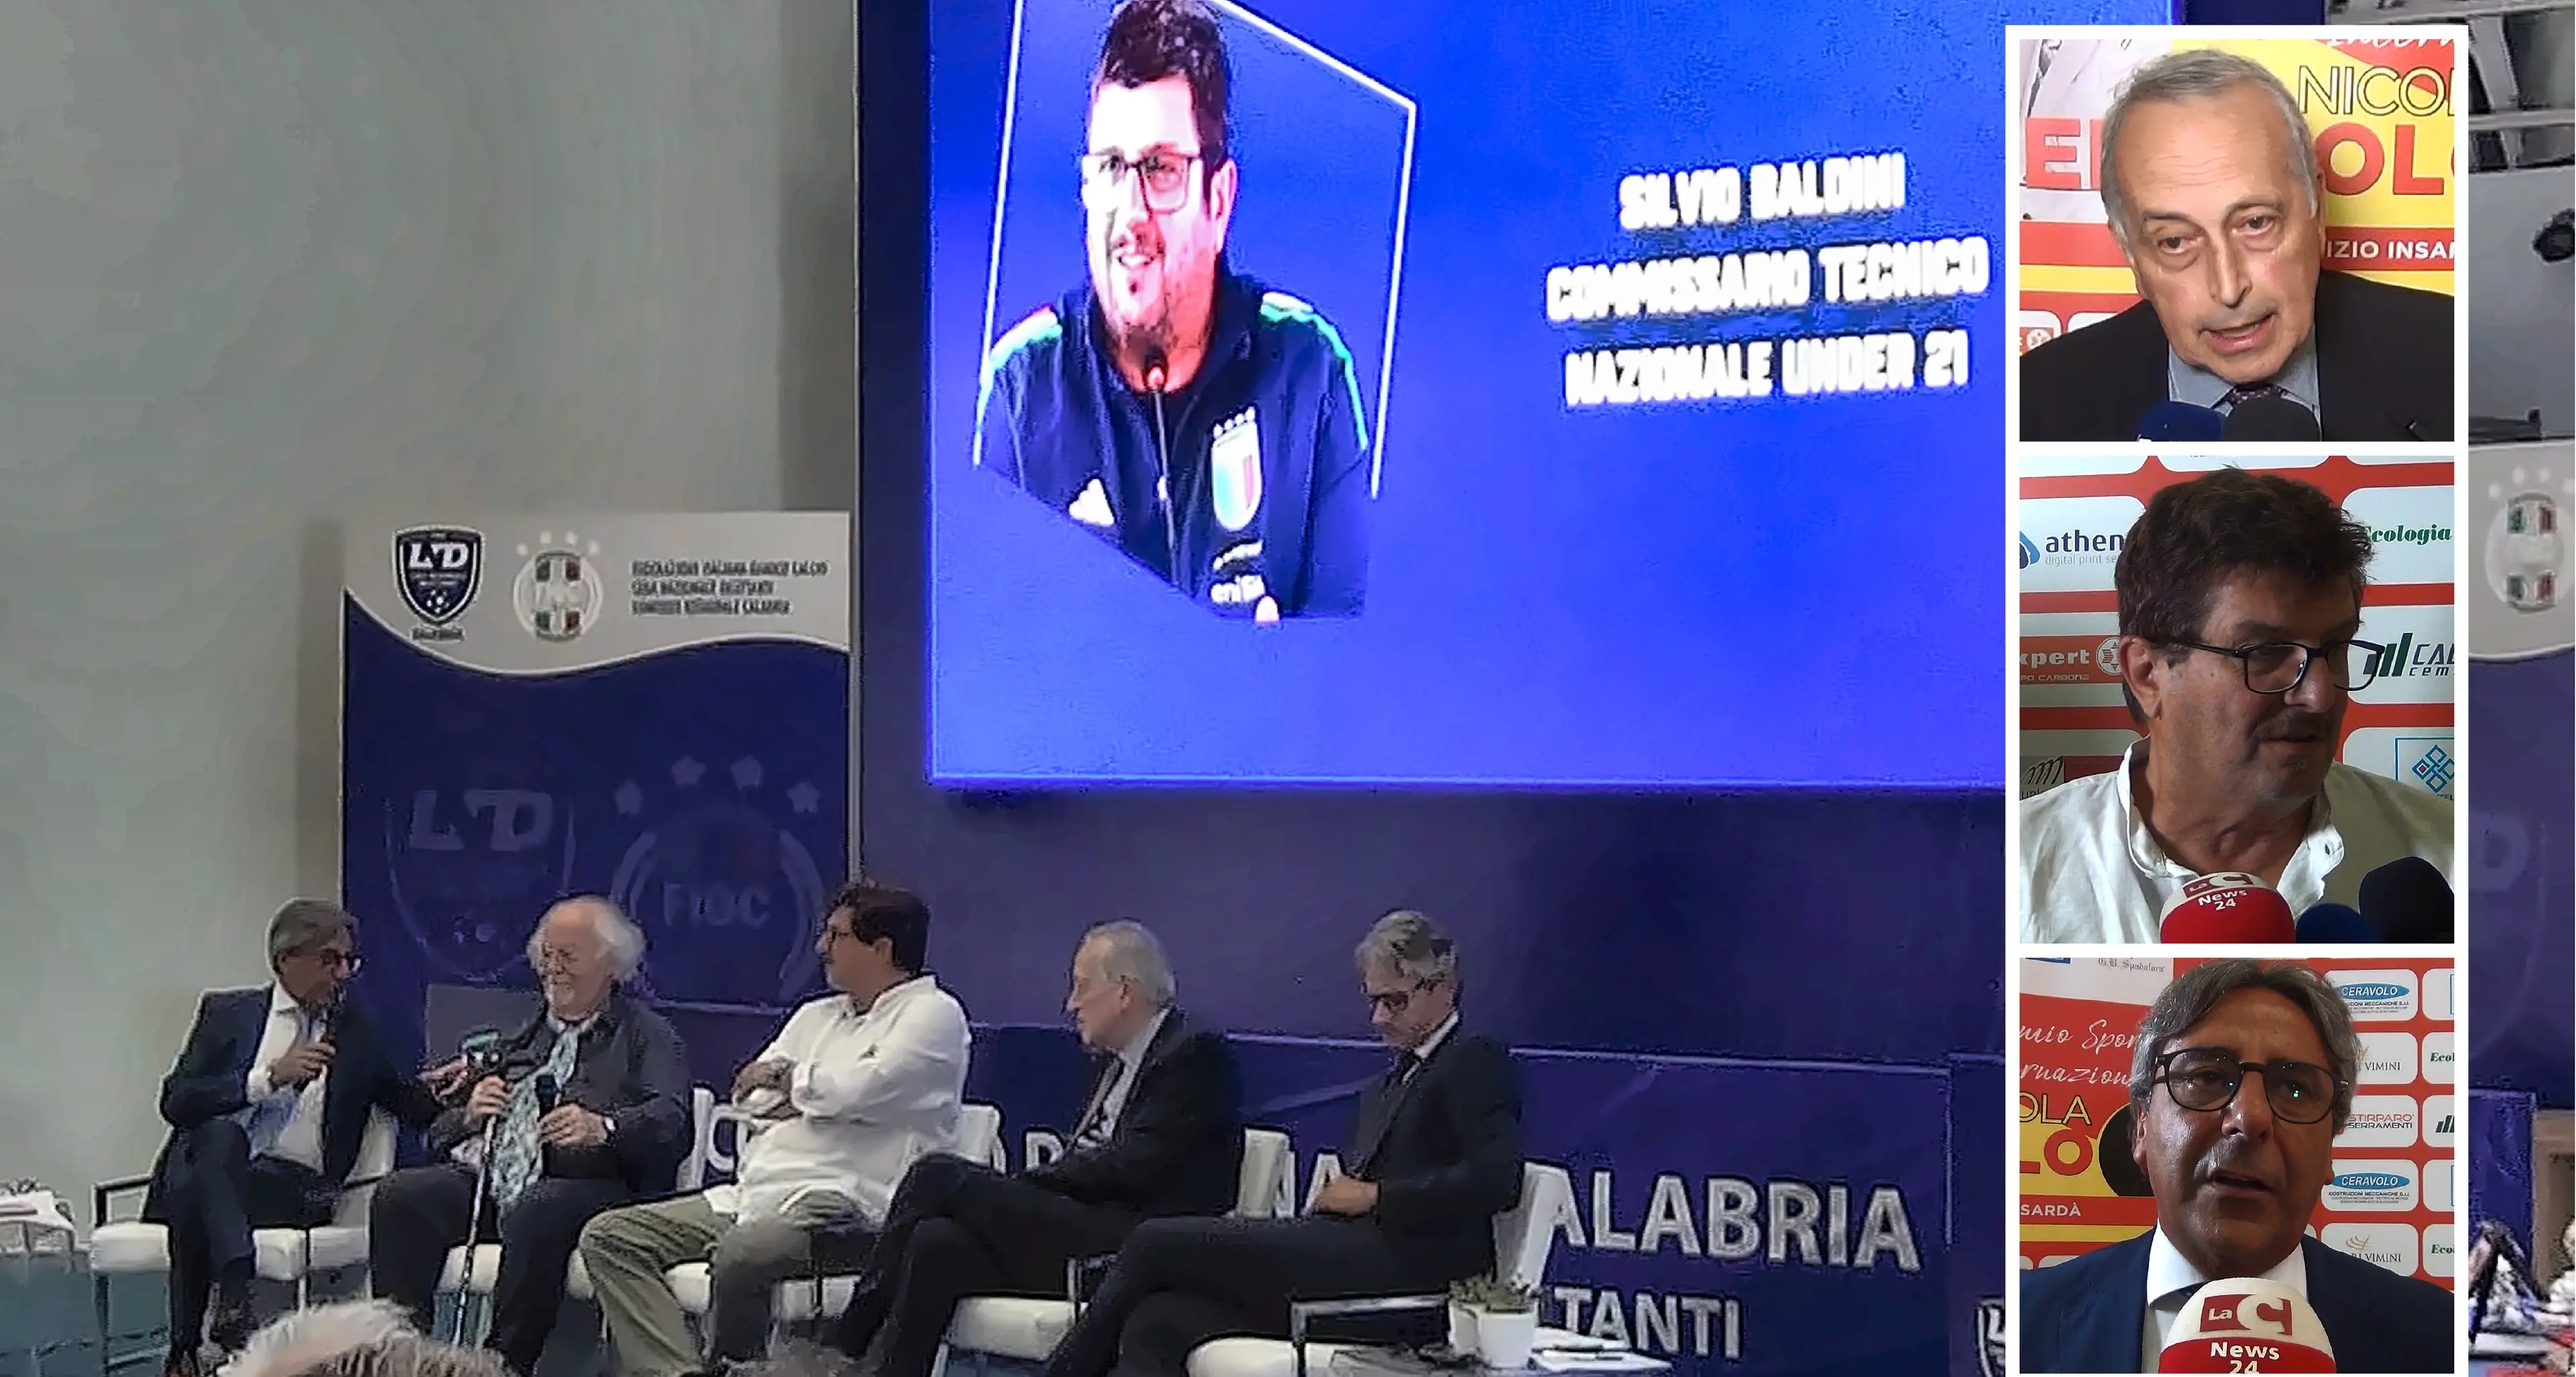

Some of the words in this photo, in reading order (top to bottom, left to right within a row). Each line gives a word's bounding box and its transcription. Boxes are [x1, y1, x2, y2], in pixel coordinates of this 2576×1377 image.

[2299, 65, 2454, 117] NICO
[2314, 121, 2454, 197] OL
[1619, 166, 1741, 229] SILVIO
[1750, 152, 1905, 220] BALDINI
[1546, 249, 1811, 321] COMMISSARIO
[1818, 236, 1990, 302] TECNICO
[1564, 341, 1774, 406] NAZIONALE
[1782, 332, 1915, 394] UNDER
[1923, 329, 1970, 388] 21
[2408, 666, 2454, 677] cem
[2197, 889, 2248, 907] News
[2214, 899, 2237, 912] 24
[2341, 986, 2398, 996] CERAVOLO
[2365, 1062, 2401, 1071] VIMINI
[2348, 1113, 2413, 1122] STIRPARO
[2341, 1176, 2399, 1187] CERAVOLO
[2365, 1252, 2402, 1262] VIMINI
[2210, 1341, 2280, 1360] News
[2229, 1360, 2260, 1374] 24
